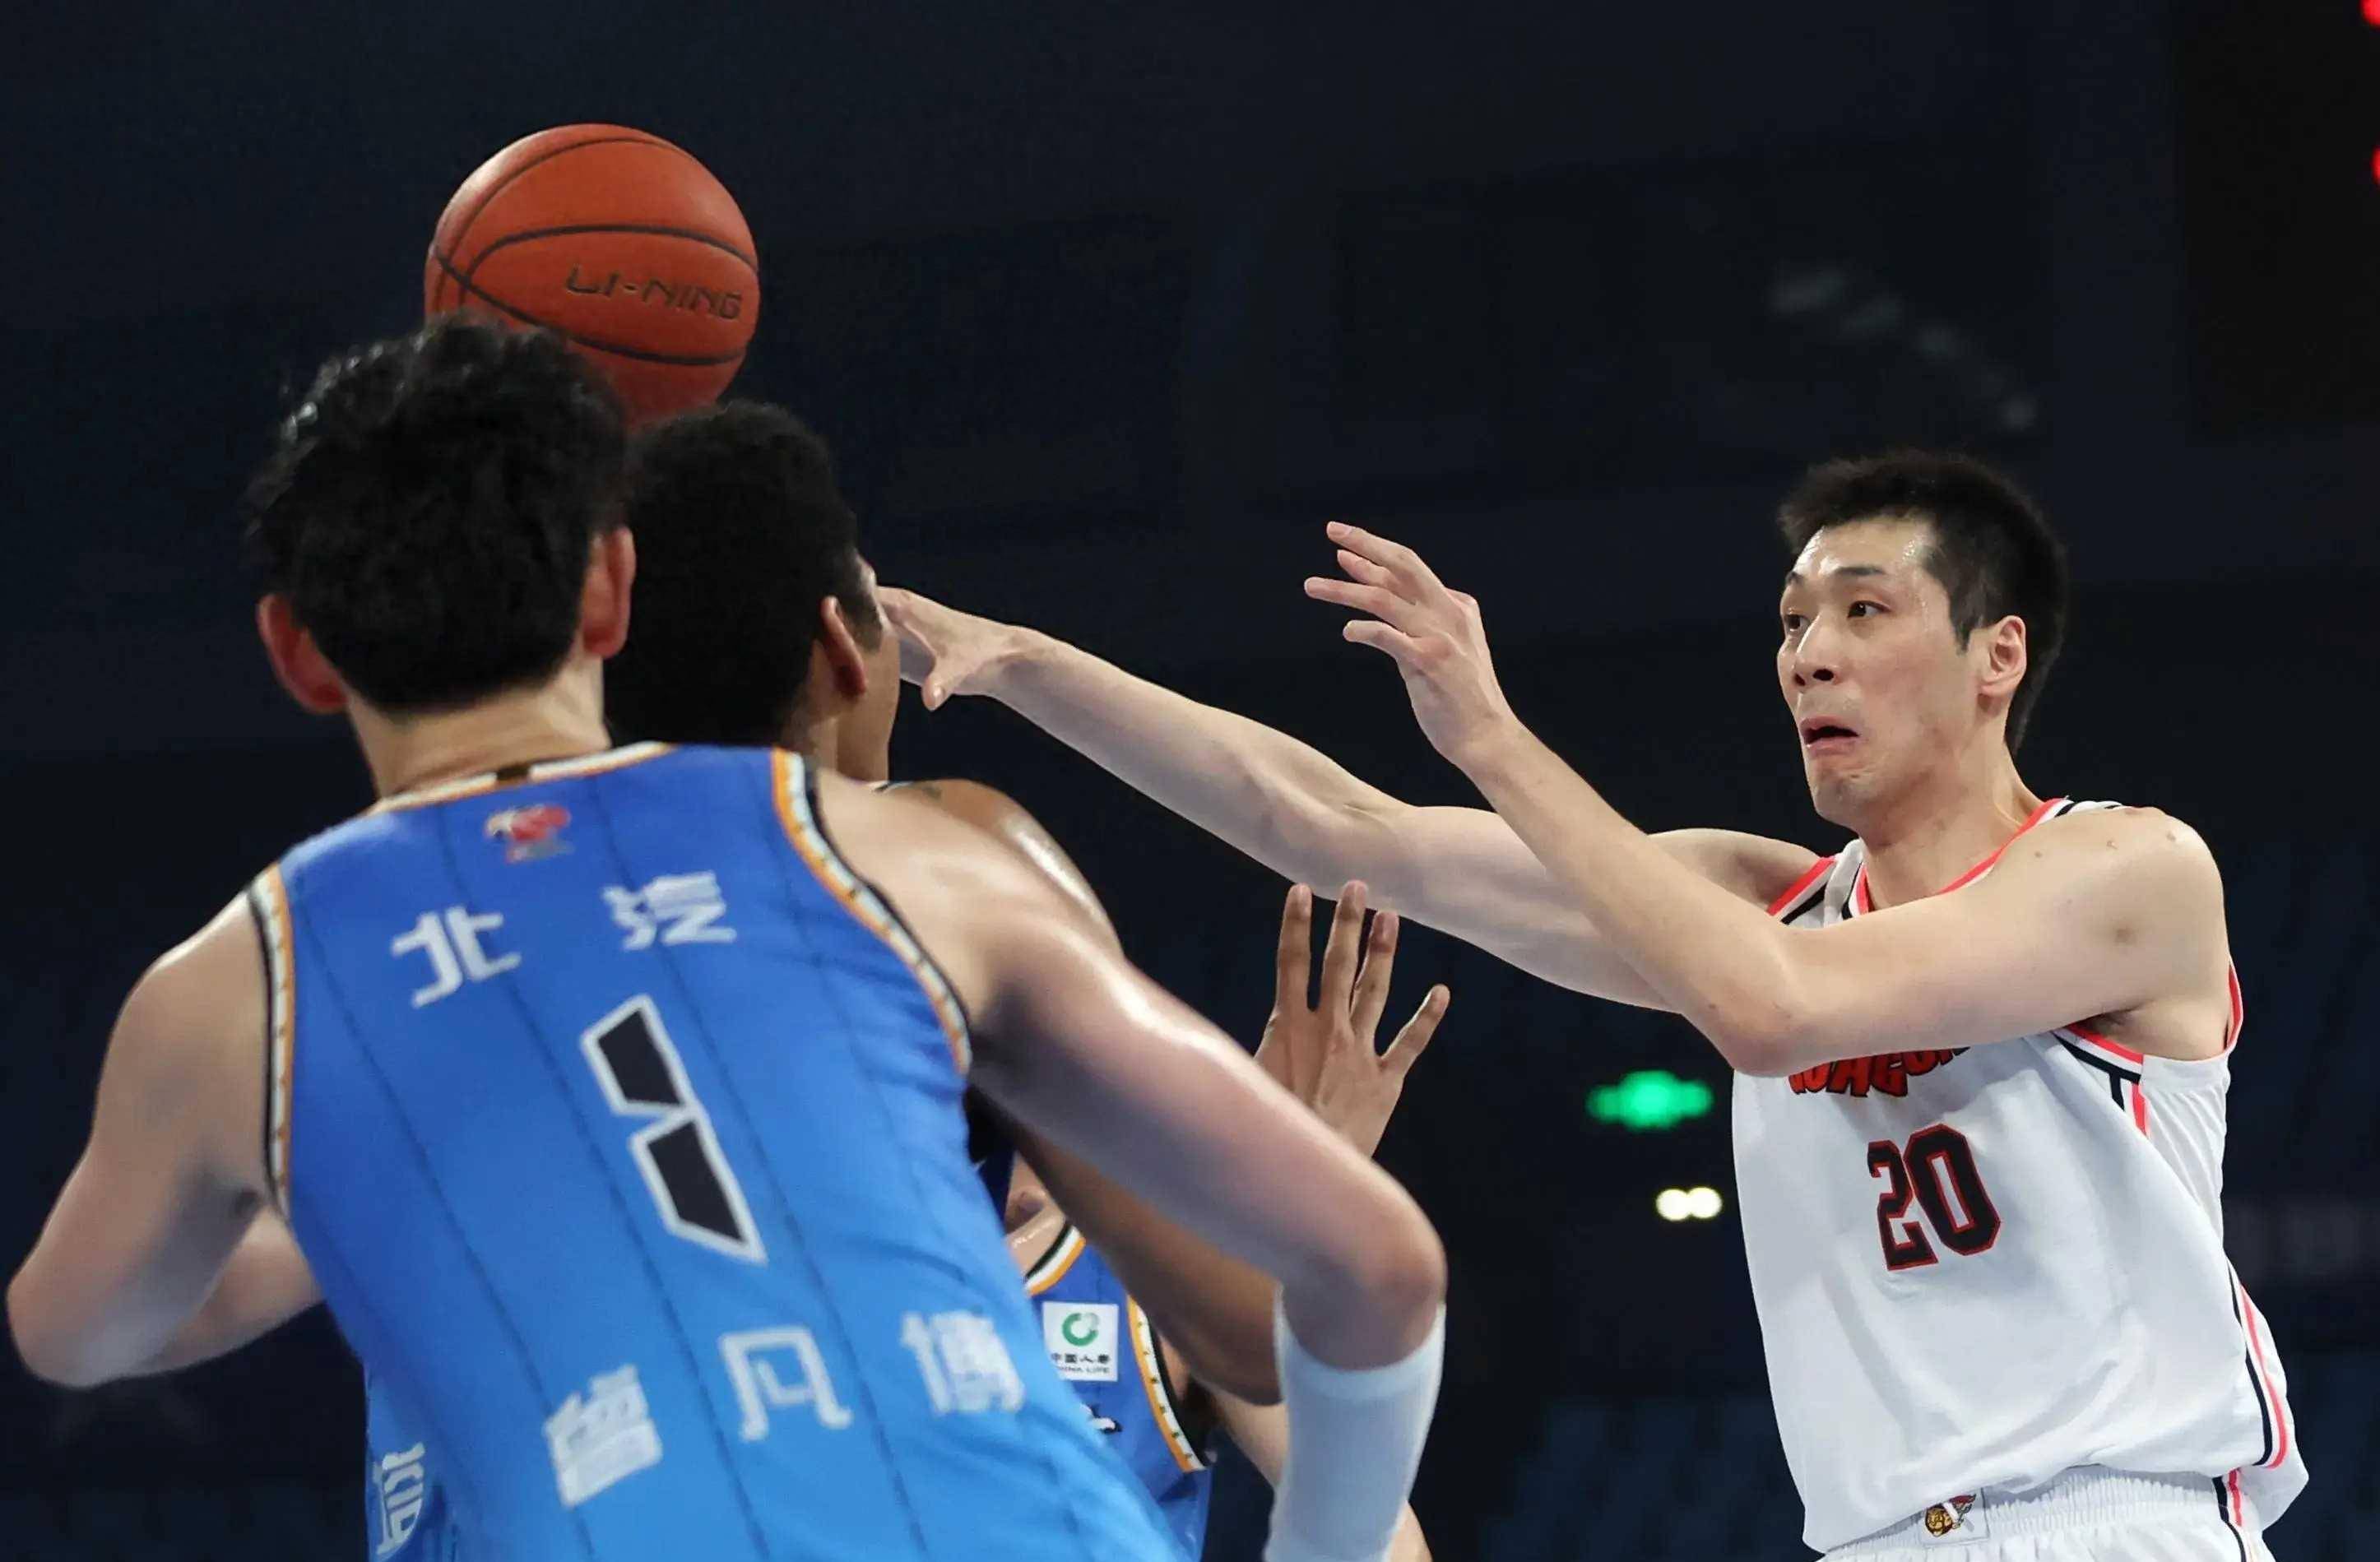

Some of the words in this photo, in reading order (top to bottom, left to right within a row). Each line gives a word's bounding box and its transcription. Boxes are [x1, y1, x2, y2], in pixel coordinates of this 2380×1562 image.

[565, 262, 742, 321] LI-NING
[579, 993, 770, 1268] 1
[1866, 1122, 2002, 1272] 20
